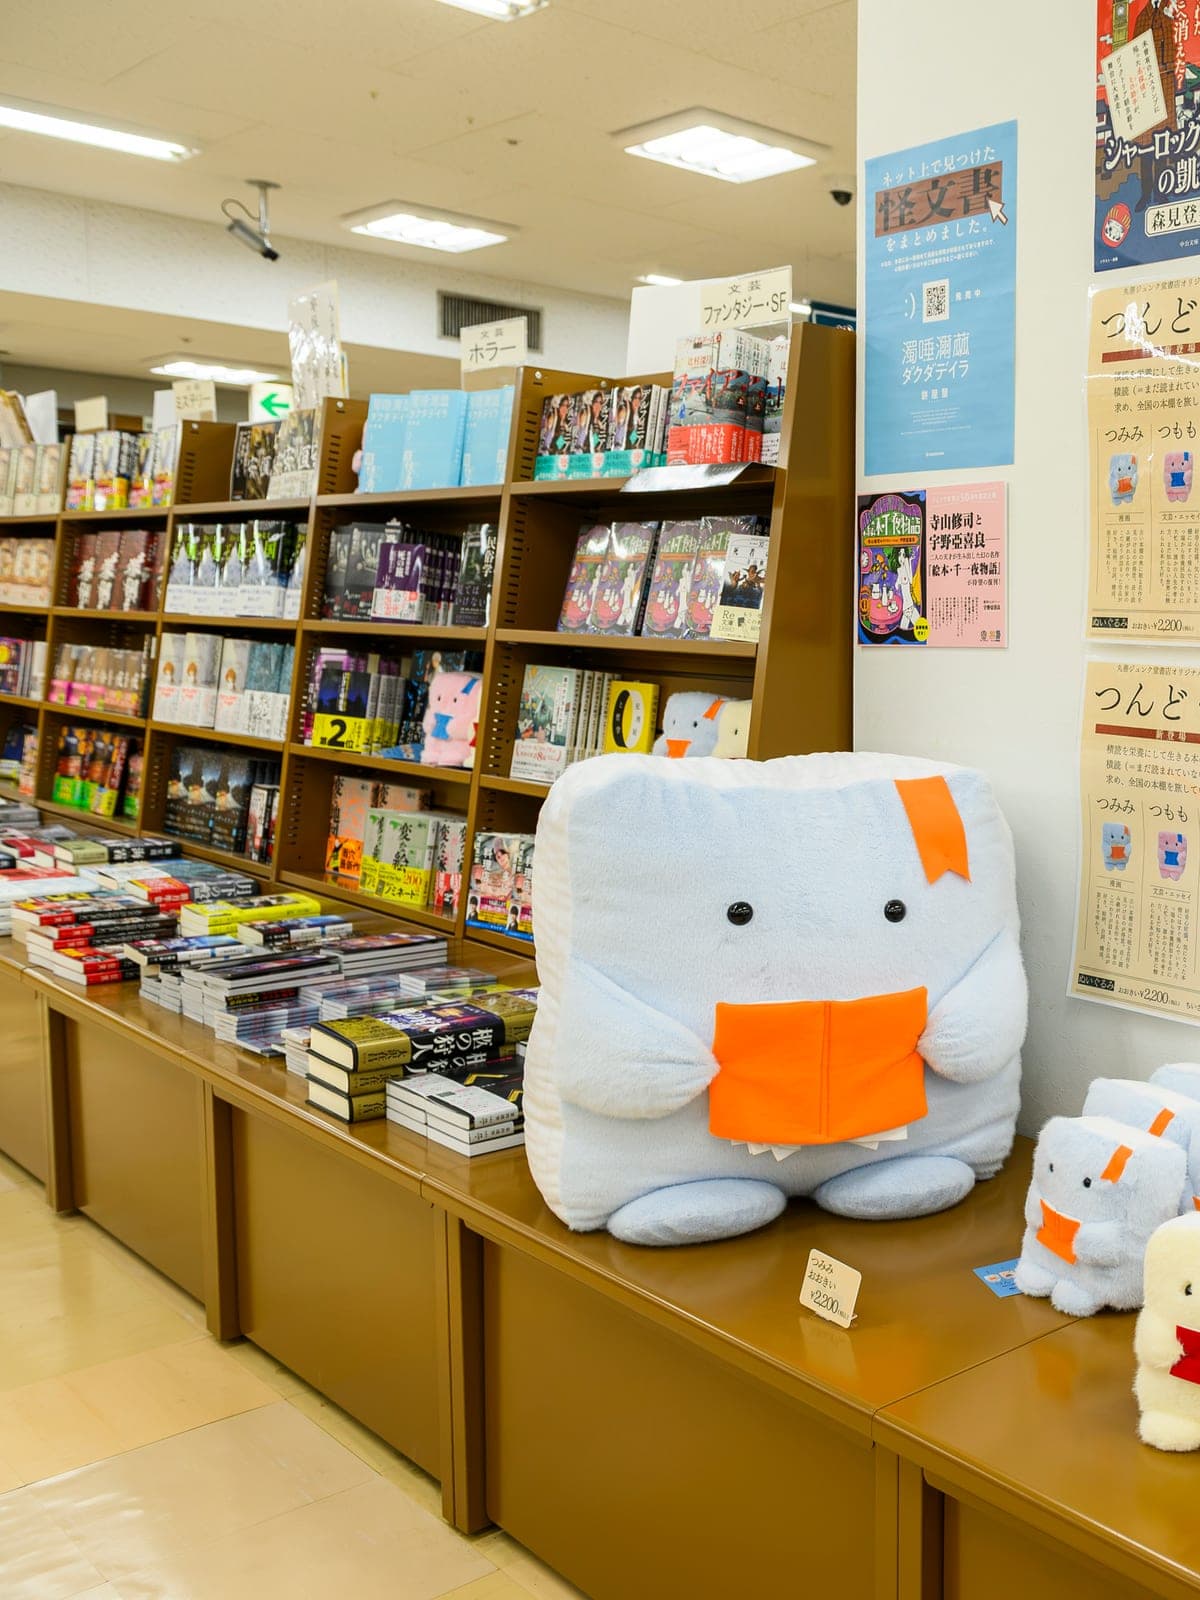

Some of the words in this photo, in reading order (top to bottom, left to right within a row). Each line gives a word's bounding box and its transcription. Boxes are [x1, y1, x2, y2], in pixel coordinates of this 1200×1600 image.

[882, 146, 996, 187] ネット上で見つけた
[878, 168, 1000, 232] 怪文書
[886, 219, 988, 252] をまとめました。
[704, 291, 787, 325] ファンタジー・SF
[469, 341, 517, 363] ホラー
[902, 360, 969, 385] ダクダデイラ
[1105, 425, 1144, 443] つみみ
[1158, 420, 1197, 440] つもも
[930, 511, 982, 531] 寺山修司と
[929, 562, 1001, 577] 『絵本・千一夜物語』
[1097, 798, 1136, 815] つみみ
[1149, 803, 1188, 822] つもも
[392, 822, 413, 873] 変な絵
[811, 1257, 834, 1275] つみみ
[807, 1268, 836, 1290] おおきい
